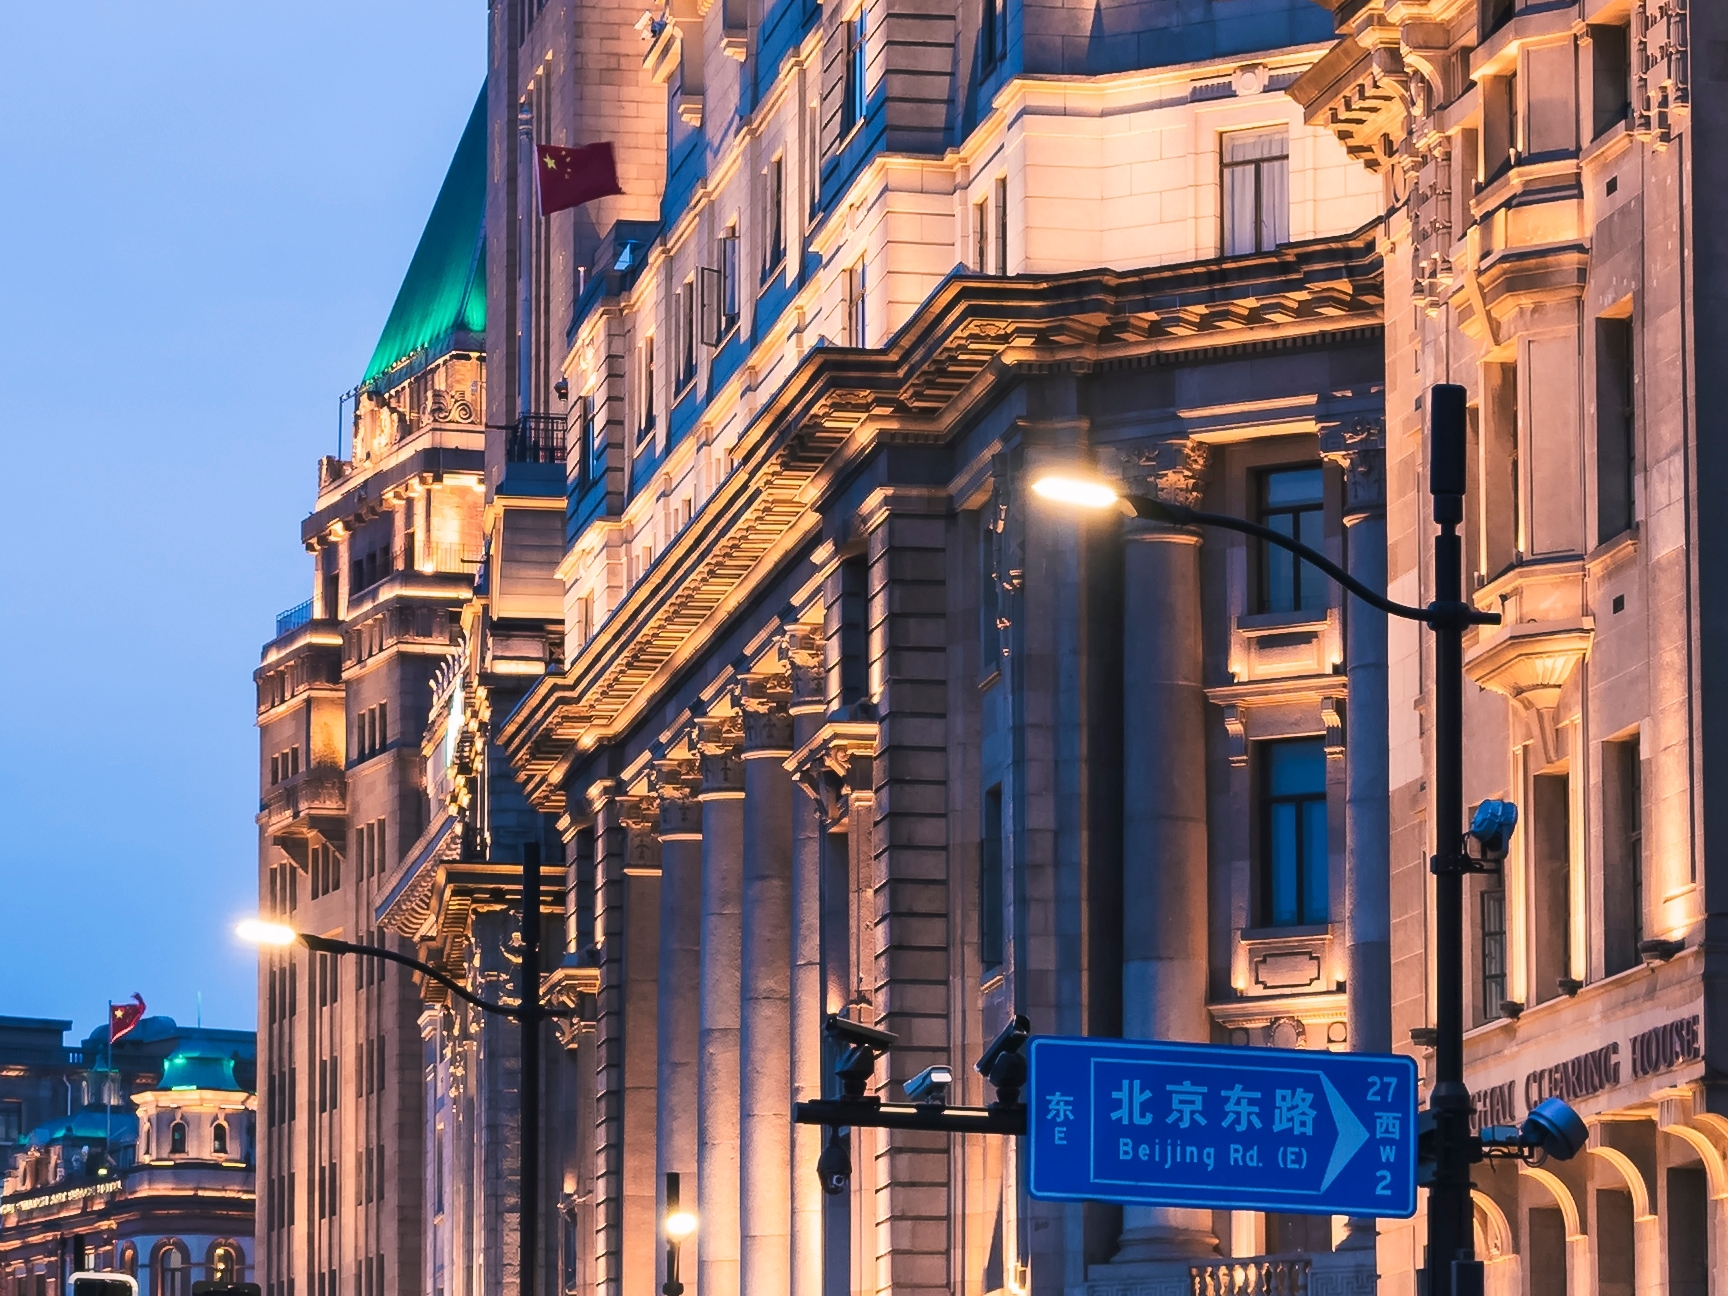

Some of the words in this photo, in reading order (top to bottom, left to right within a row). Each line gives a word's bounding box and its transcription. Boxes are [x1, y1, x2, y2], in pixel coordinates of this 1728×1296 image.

[1525, 1041, 1622, 1112] CLEARING
[1629, 1013, 1701, 1081] HOUSE
[1366, 1076, 1398, 1103] 27
[1045, 1091, 1075, 1124] 东
[1110, 1078, 1318, 1137] 北京东路
[1054, 1127, 1068, 1145] E
[1374, 1112, 1402, 1141] 西
[1119, 1138, 1215, 1171] Beijing
[1229, 1142, 1263, 1167] Rd.
[1278, 1147, 1308, 1170] (E)
[1379, 1145, 1396, 1163] W
[1375, 1170, 1392, 1196] 2
